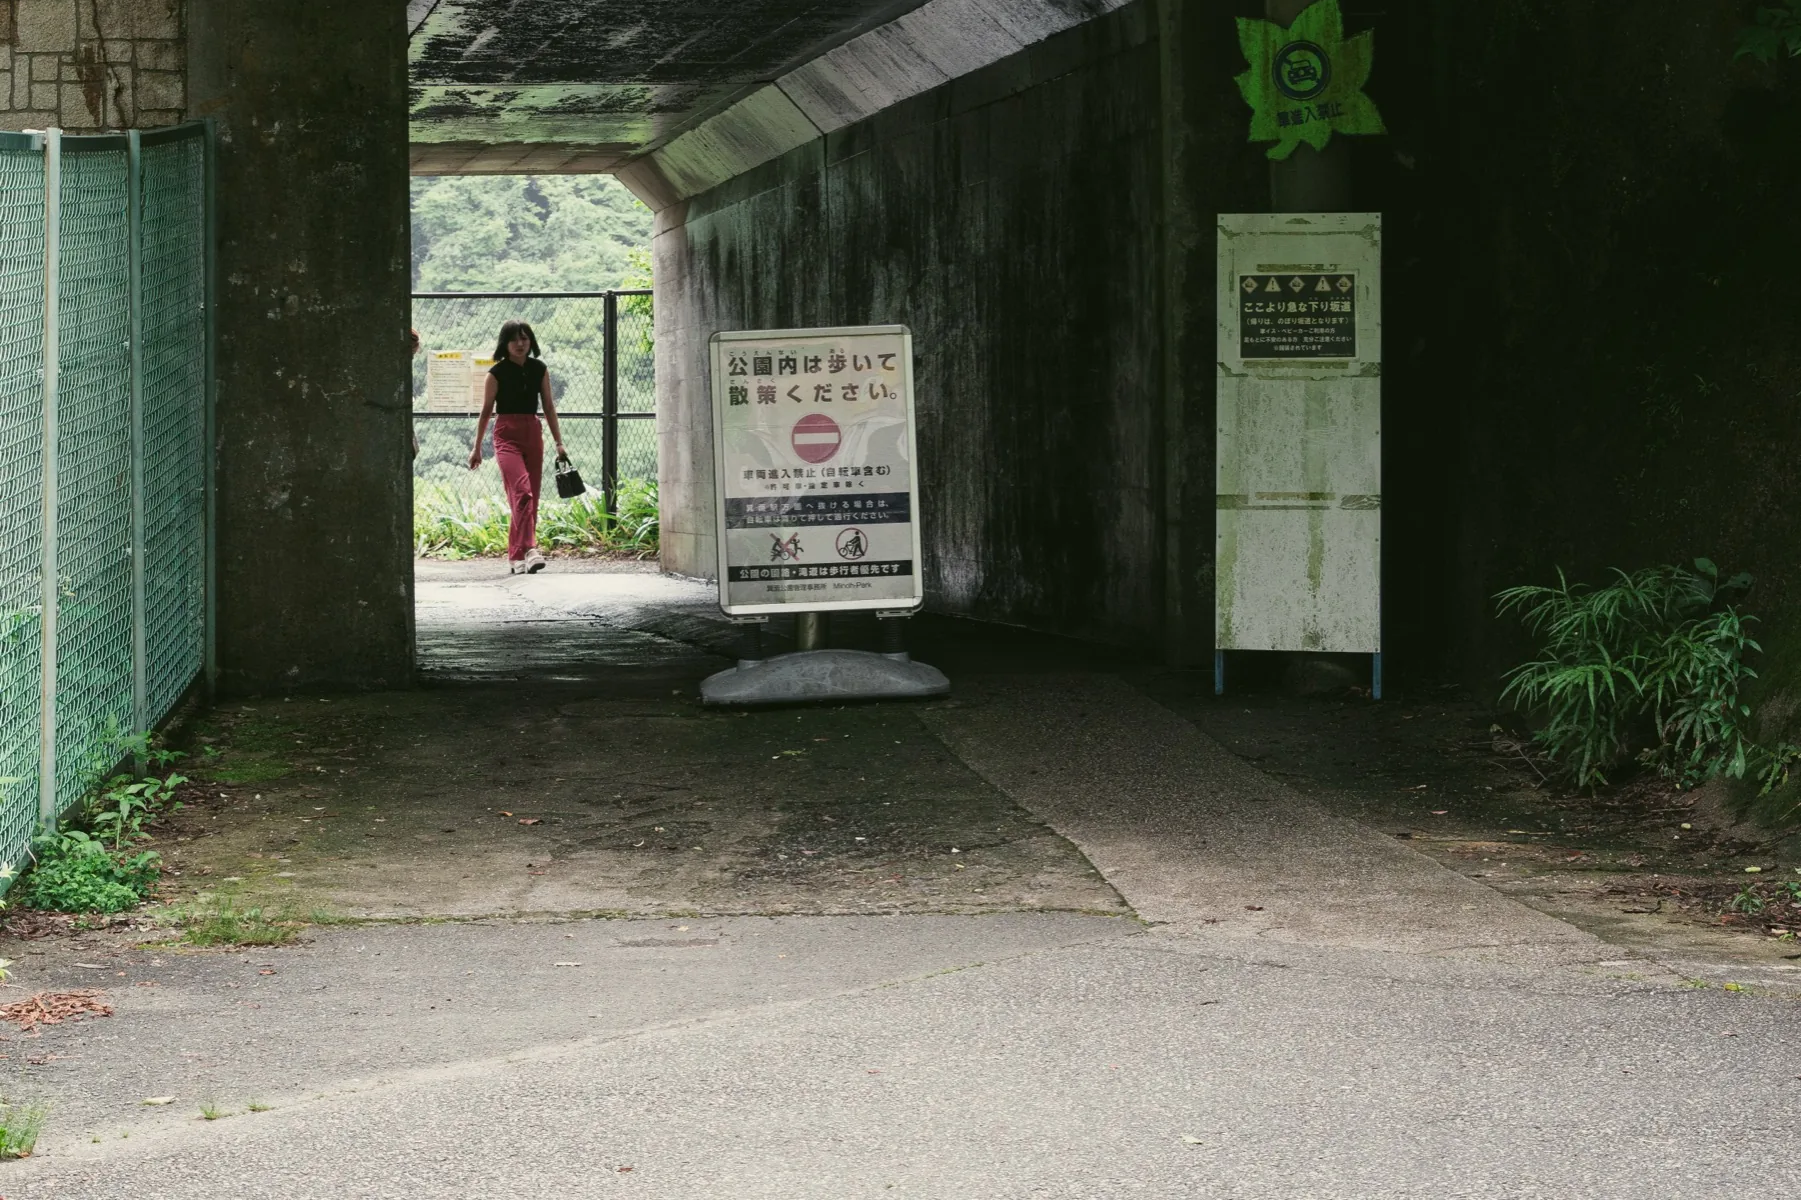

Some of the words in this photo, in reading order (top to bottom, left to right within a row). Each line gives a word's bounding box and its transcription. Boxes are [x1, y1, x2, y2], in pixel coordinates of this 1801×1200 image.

[1244, 301, 1352, 313] ここより急な下り坂道
[728, 352, 897, 377] 公園内は歩いて
[728, 383, 898, 406] 散策ください。
